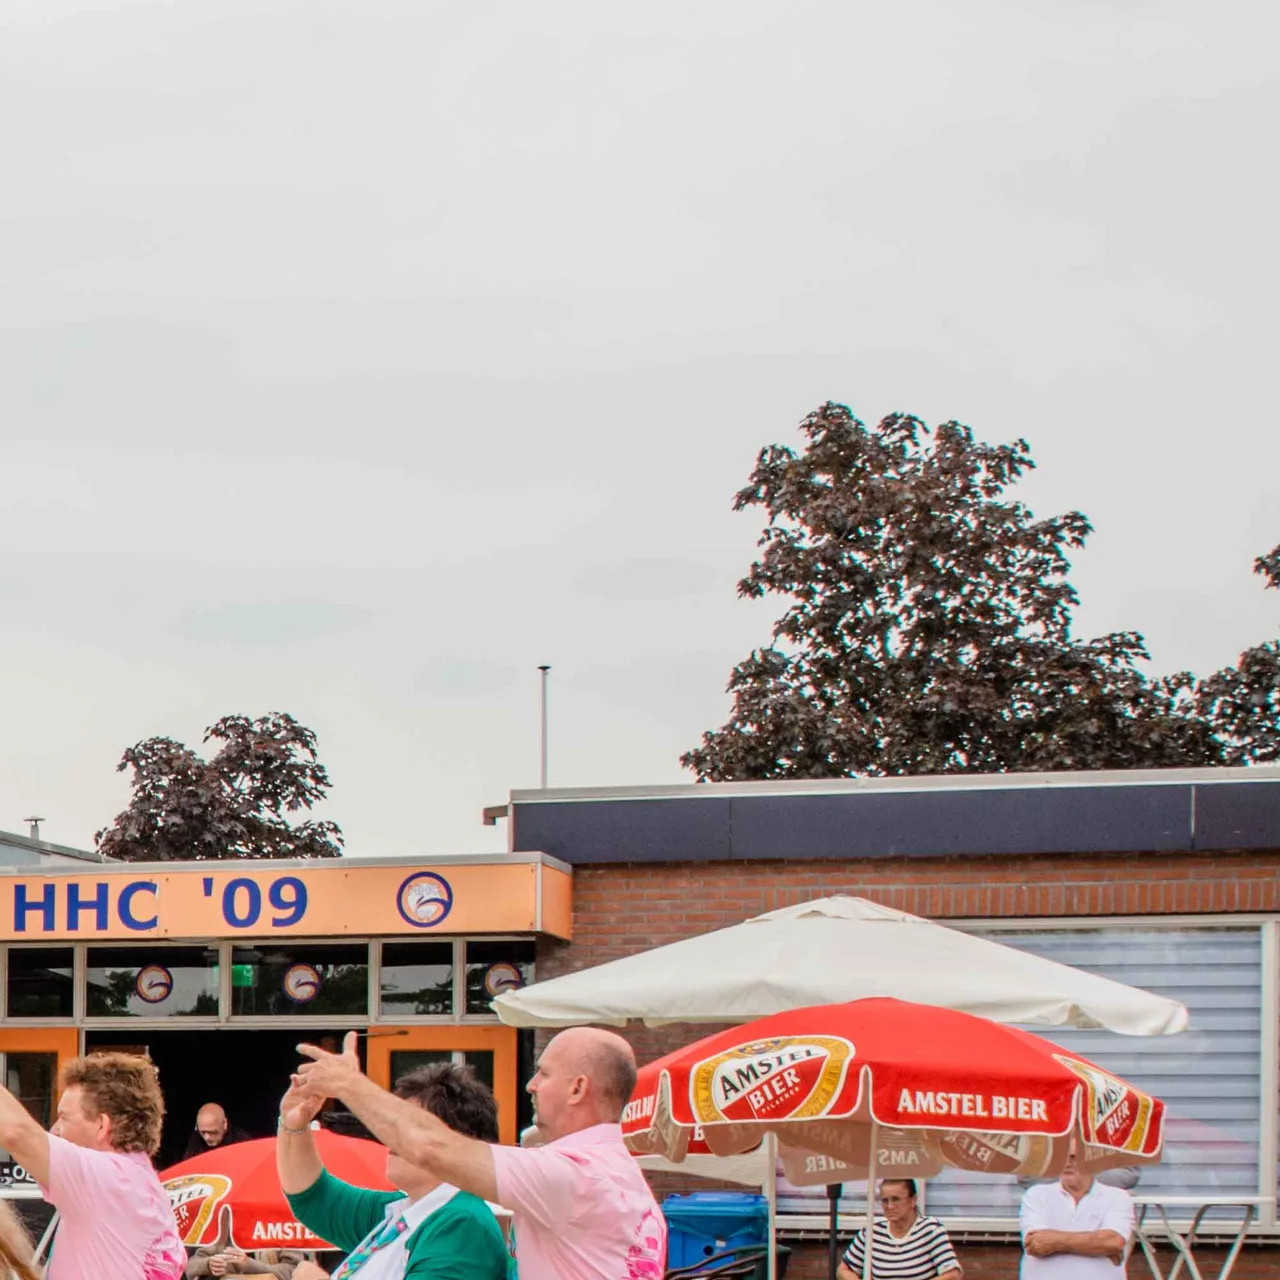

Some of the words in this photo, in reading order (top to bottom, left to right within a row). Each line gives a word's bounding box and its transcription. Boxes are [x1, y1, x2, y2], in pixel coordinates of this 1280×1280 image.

[13, 881, 159, 932] HHC
[202, 876, 309, 928] '09
[720, 1049, 820, 1100] AMSTEL
[749, 1068, 800, 1110] BIER
[897, 1088, 988, 1117] AMSTEL
[992, 1095, 1048, 1121] BIER
[252, 1220, 320, 1240] AMSTE
